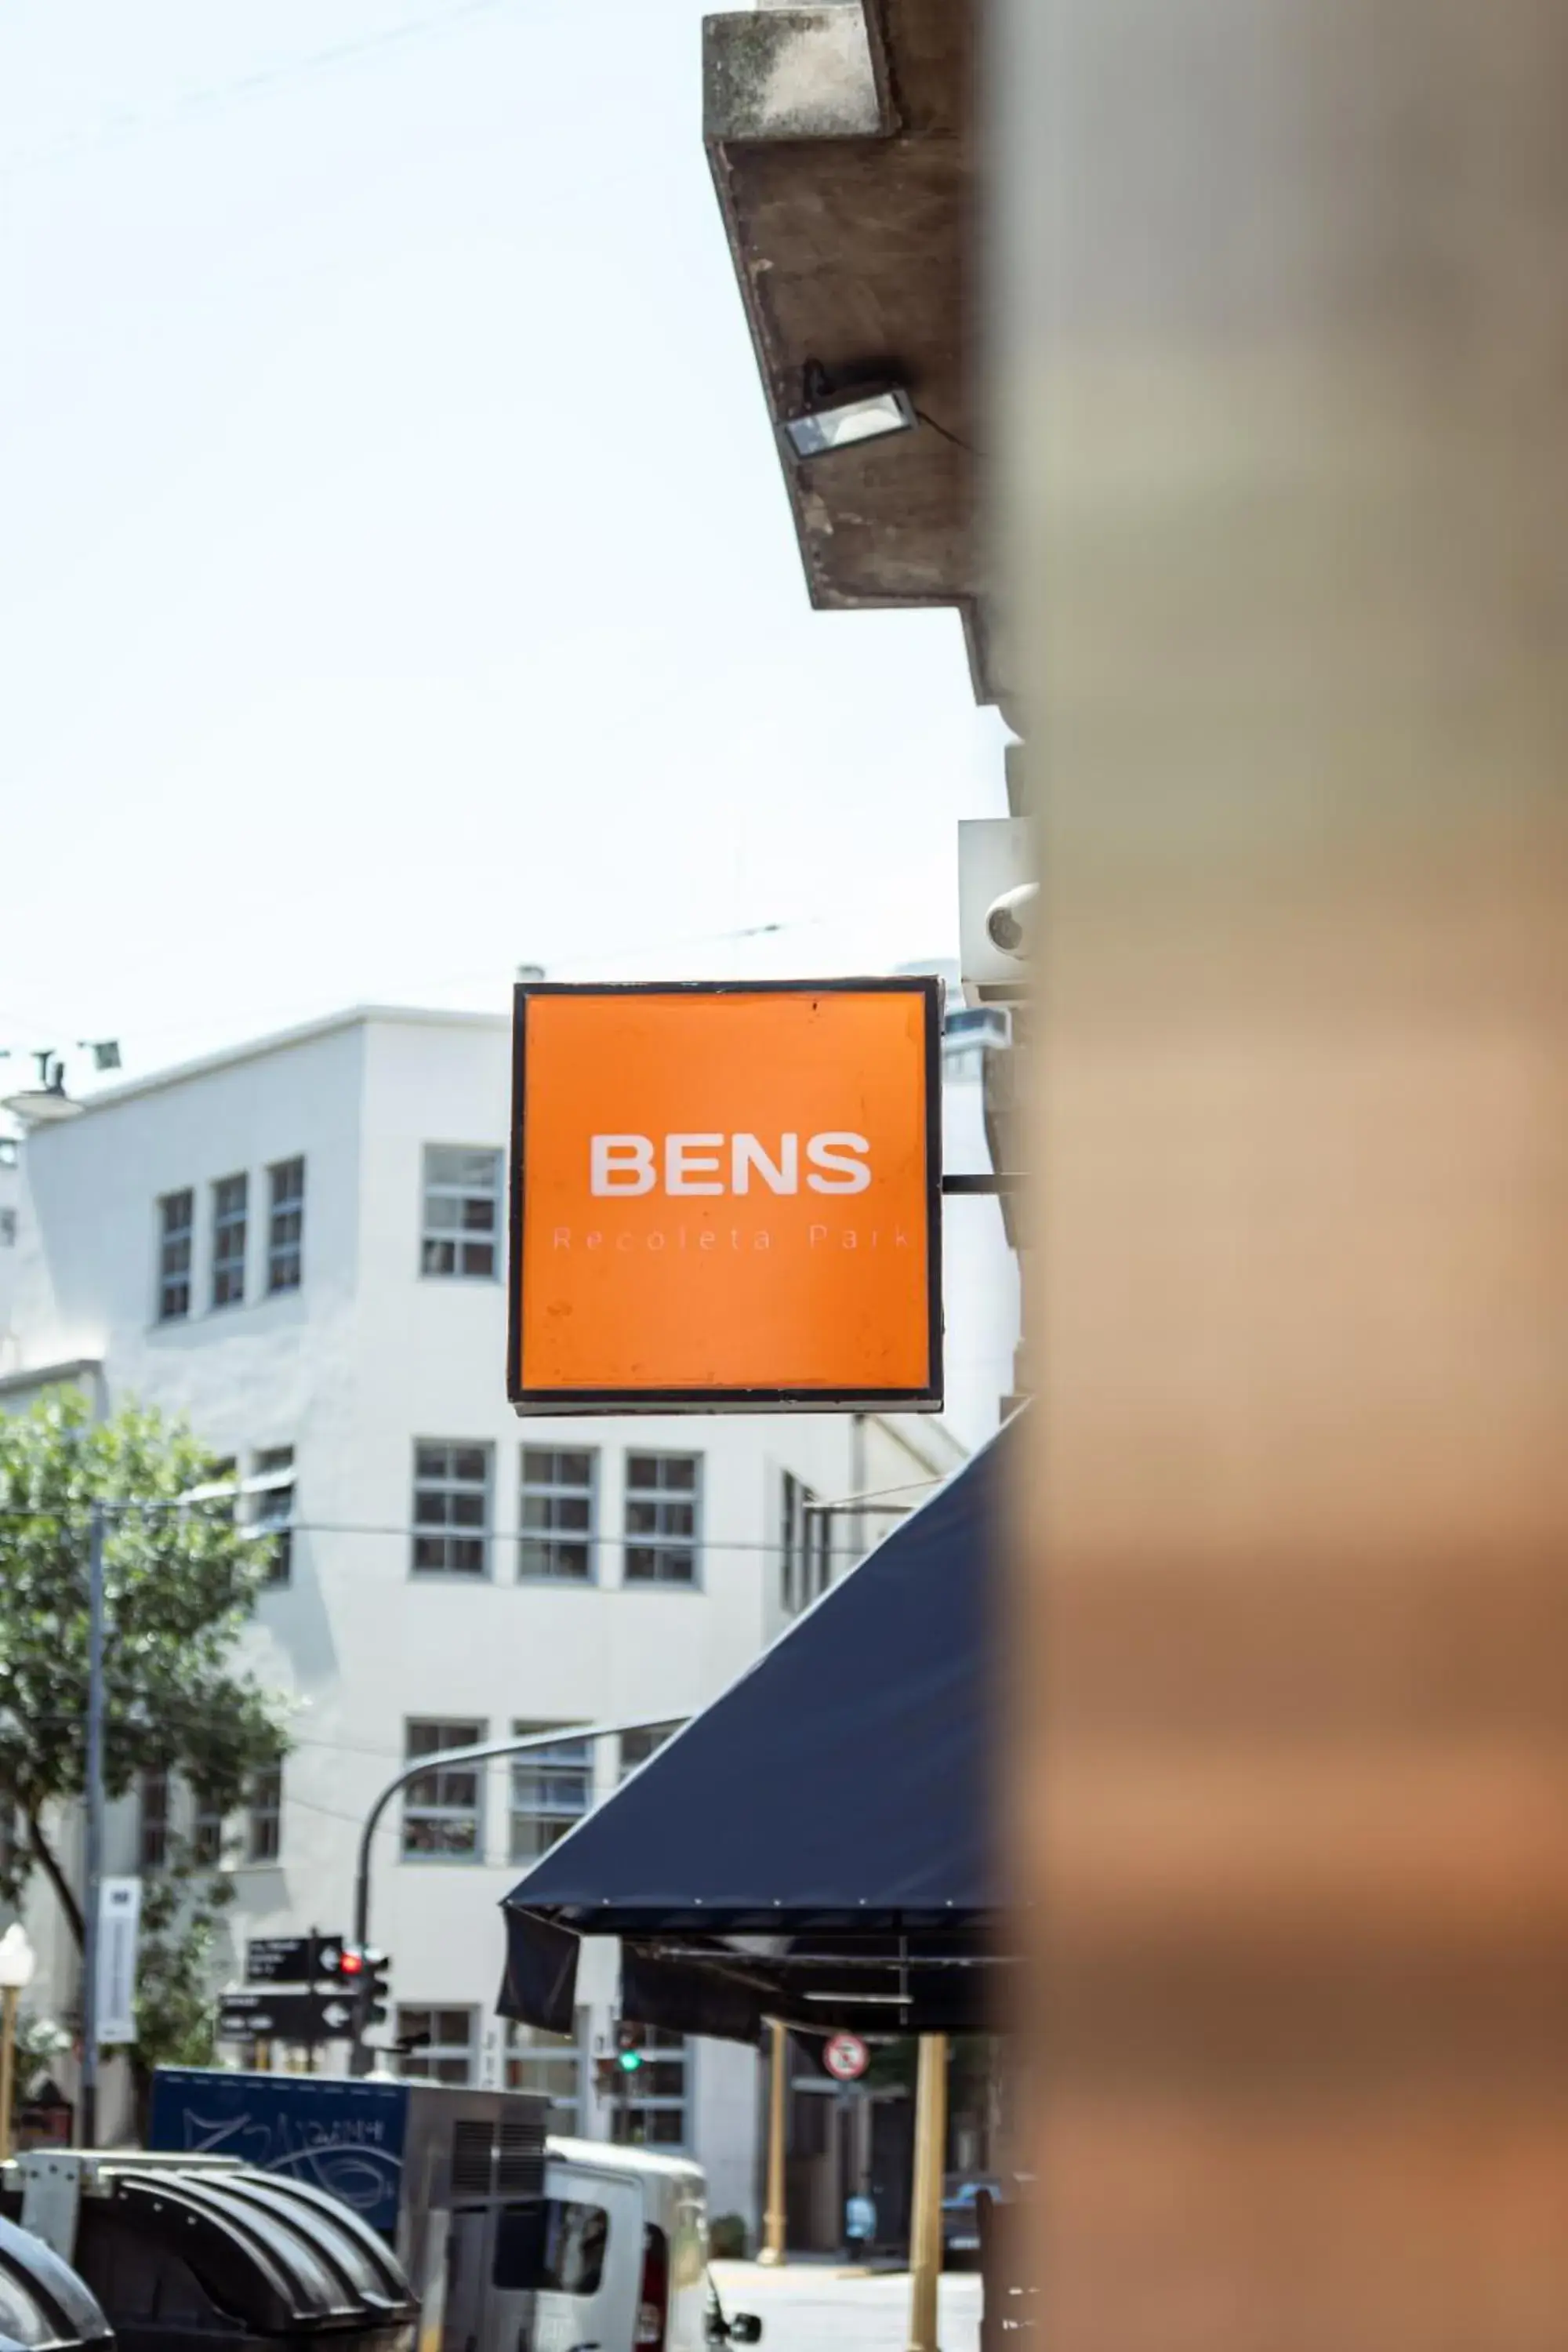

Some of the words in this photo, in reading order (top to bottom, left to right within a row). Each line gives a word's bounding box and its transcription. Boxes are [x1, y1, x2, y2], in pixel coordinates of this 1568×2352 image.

[590, 1132, 872, 1197] BENS
[553, 1226, 771, 1251] Recoleta
[808, 1224, 909, 1250] Park
